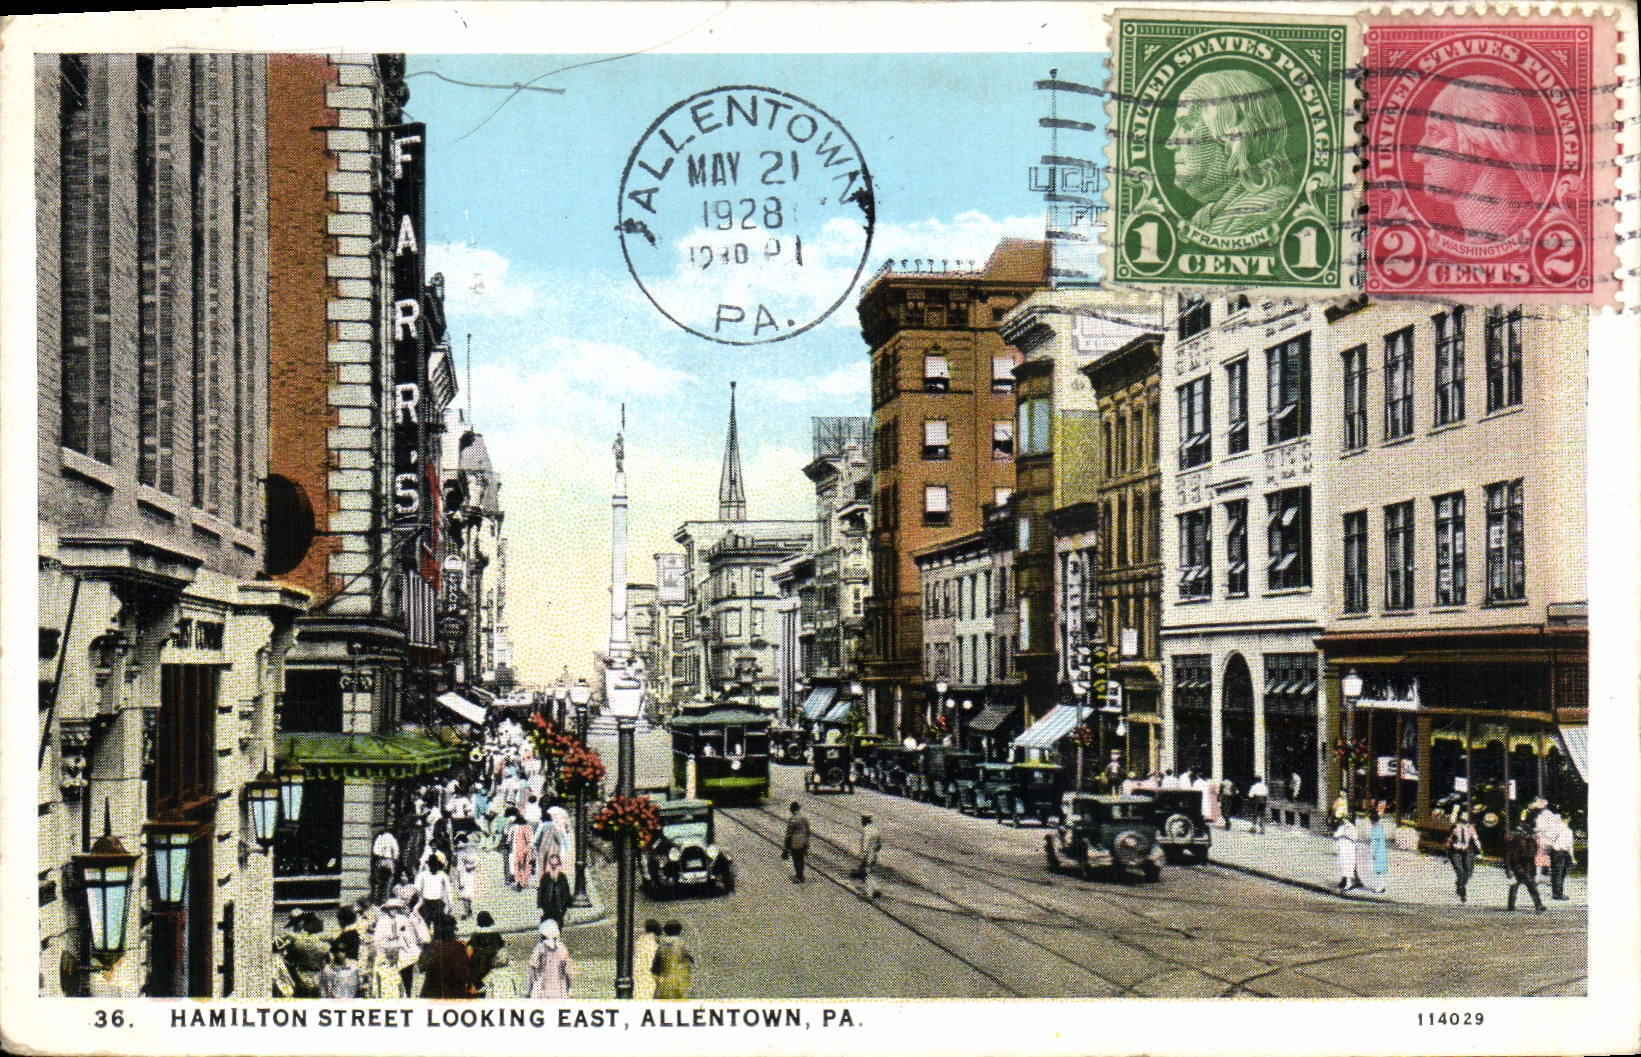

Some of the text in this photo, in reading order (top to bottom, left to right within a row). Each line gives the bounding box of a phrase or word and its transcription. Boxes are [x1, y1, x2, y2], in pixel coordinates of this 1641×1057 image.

[1131, 35, 1330, 167] UNITED STATES POSTAGE
[1417, 38, 1520, 71] STATES
[1520, 53, 1582, 171] POSTAGE
[628, 95, 861, 214] ALLENTOWN
[688, 150, 799, 188] MAY 21
[702, 196, 784, 231] 1928
[1132, 221, 1166, 264] 1
[1190, 230, 1266, 249] FRANKLIN
[1292, 226, 1324, 269] 1
[1382, 229, 1416, 277] 2
[1442, 237, 1521, 257] WASHINGTON
[1542, 229, 1576, 277] 2
[1177, 253, 1276, 277] CENT
[1426, 262, 1532, 285] CENTS
[394, 134, 422, 514] FARR'S
[714, 303, 796, 335] PA.
[93, 1007, 864, 1030] 36. HAMILTON STREET LOOKING EAST, ALLENTOWN, PA.
[1418, 1012, 1485, 1026] 114029
